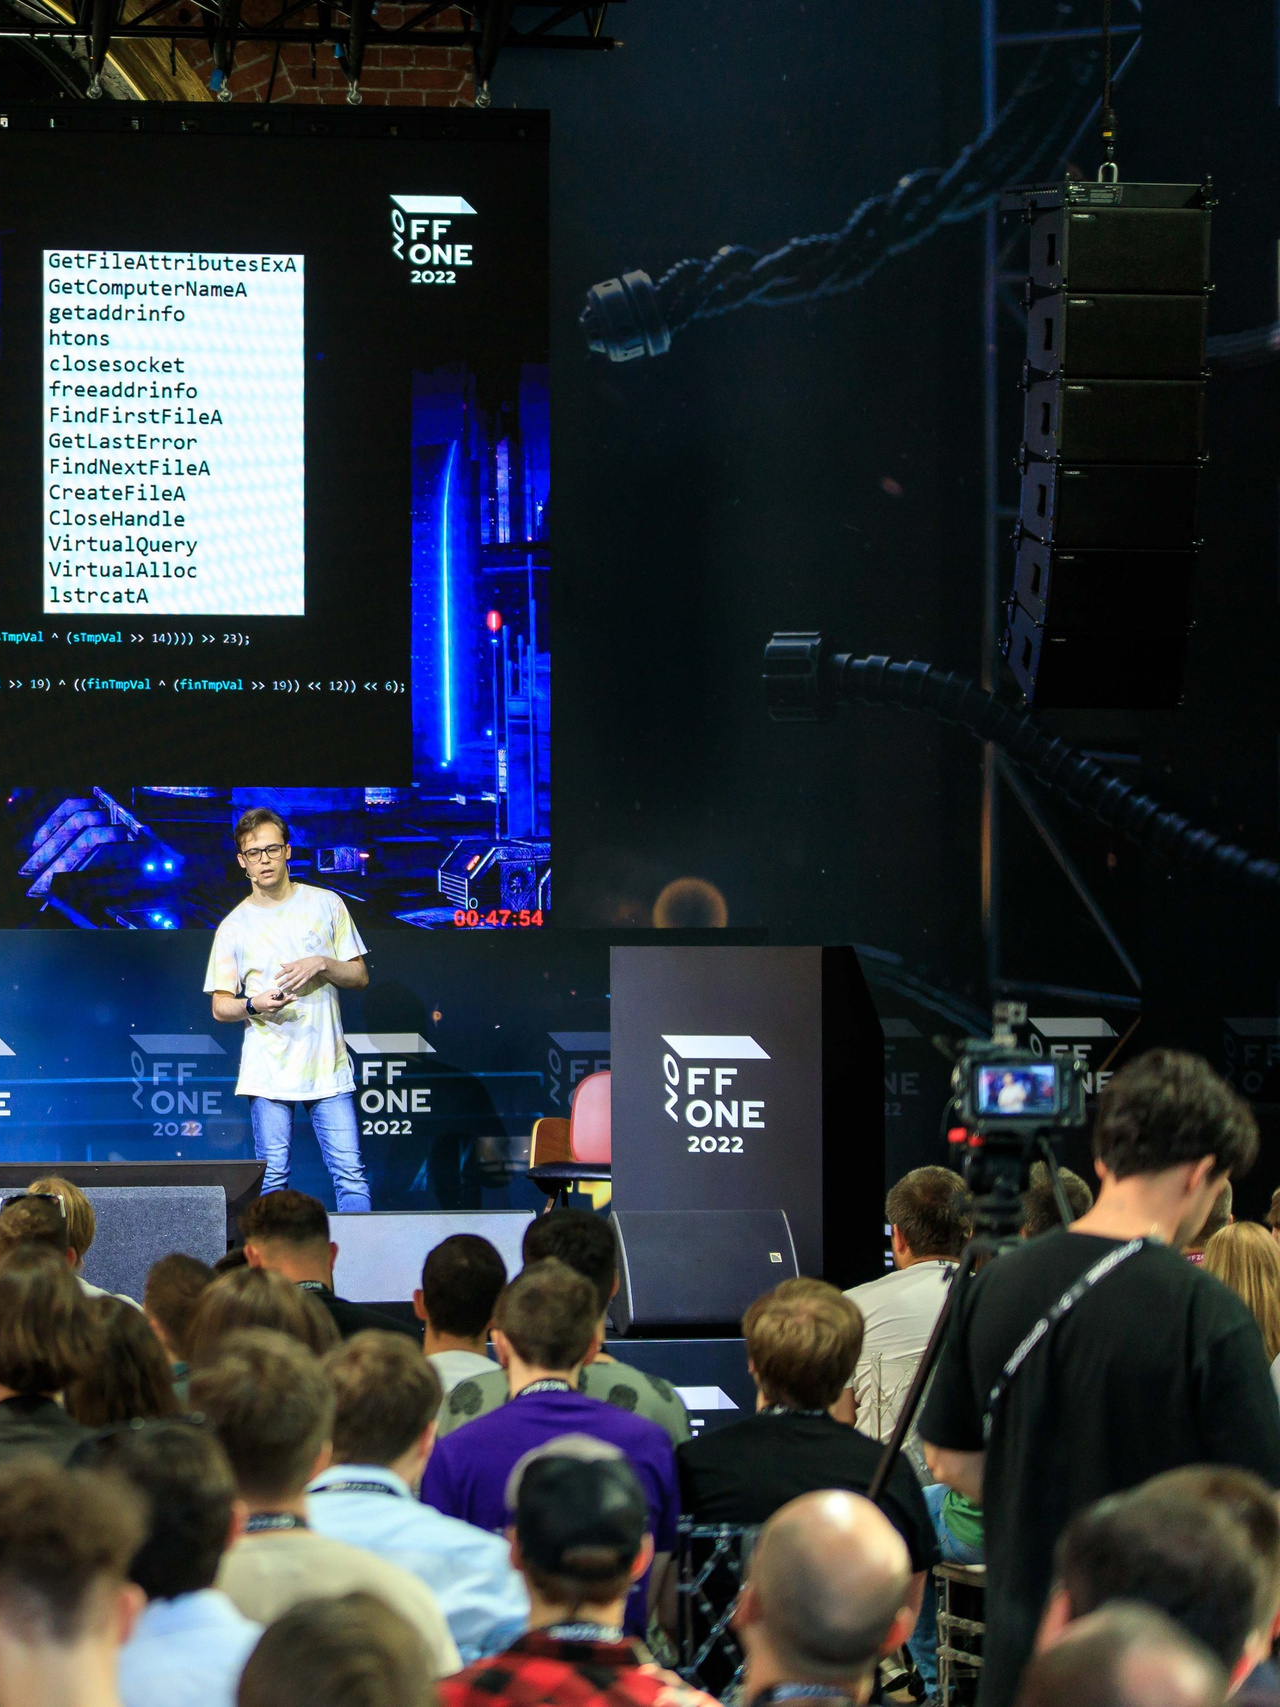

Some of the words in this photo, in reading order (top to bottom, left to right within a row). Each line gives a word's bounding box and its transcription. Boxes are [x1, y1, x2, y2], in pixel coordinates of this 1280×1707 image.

[49, 253, 296, 272] GetFileAttributesExA
[411, 270, 456, 284] 2022
[49, 278, 247, 299] GetComputerNameA
[50, 304, 185, 324] getaddrinfo
[50, 330, 109, 346] htons
[51, 355, 184, 374] closesocket
[50, 381, 197, 399] freeaddrinfo
[51, 406, 222, 425] FindFirstFileA
[49, 433, 197, 450] GetLastError
[51, 458, 210, 476] FindNextFileA
[50, 484, 185, 501] CreateFileA
[50, 509, 184, 527] CloseHandle
[49, 535, 197, 557] VirtualQuery
[49, 561, 196, 578] VirtualAlloc
[51, 586, 148, 603] lstrcatA
[454, 910, 543, 927] 00:47:54
[153, 1122, 203, 1136] 2022
[362, 1120, 412, 1135] 2022
[687, 1135, 744, 1153] 2022
